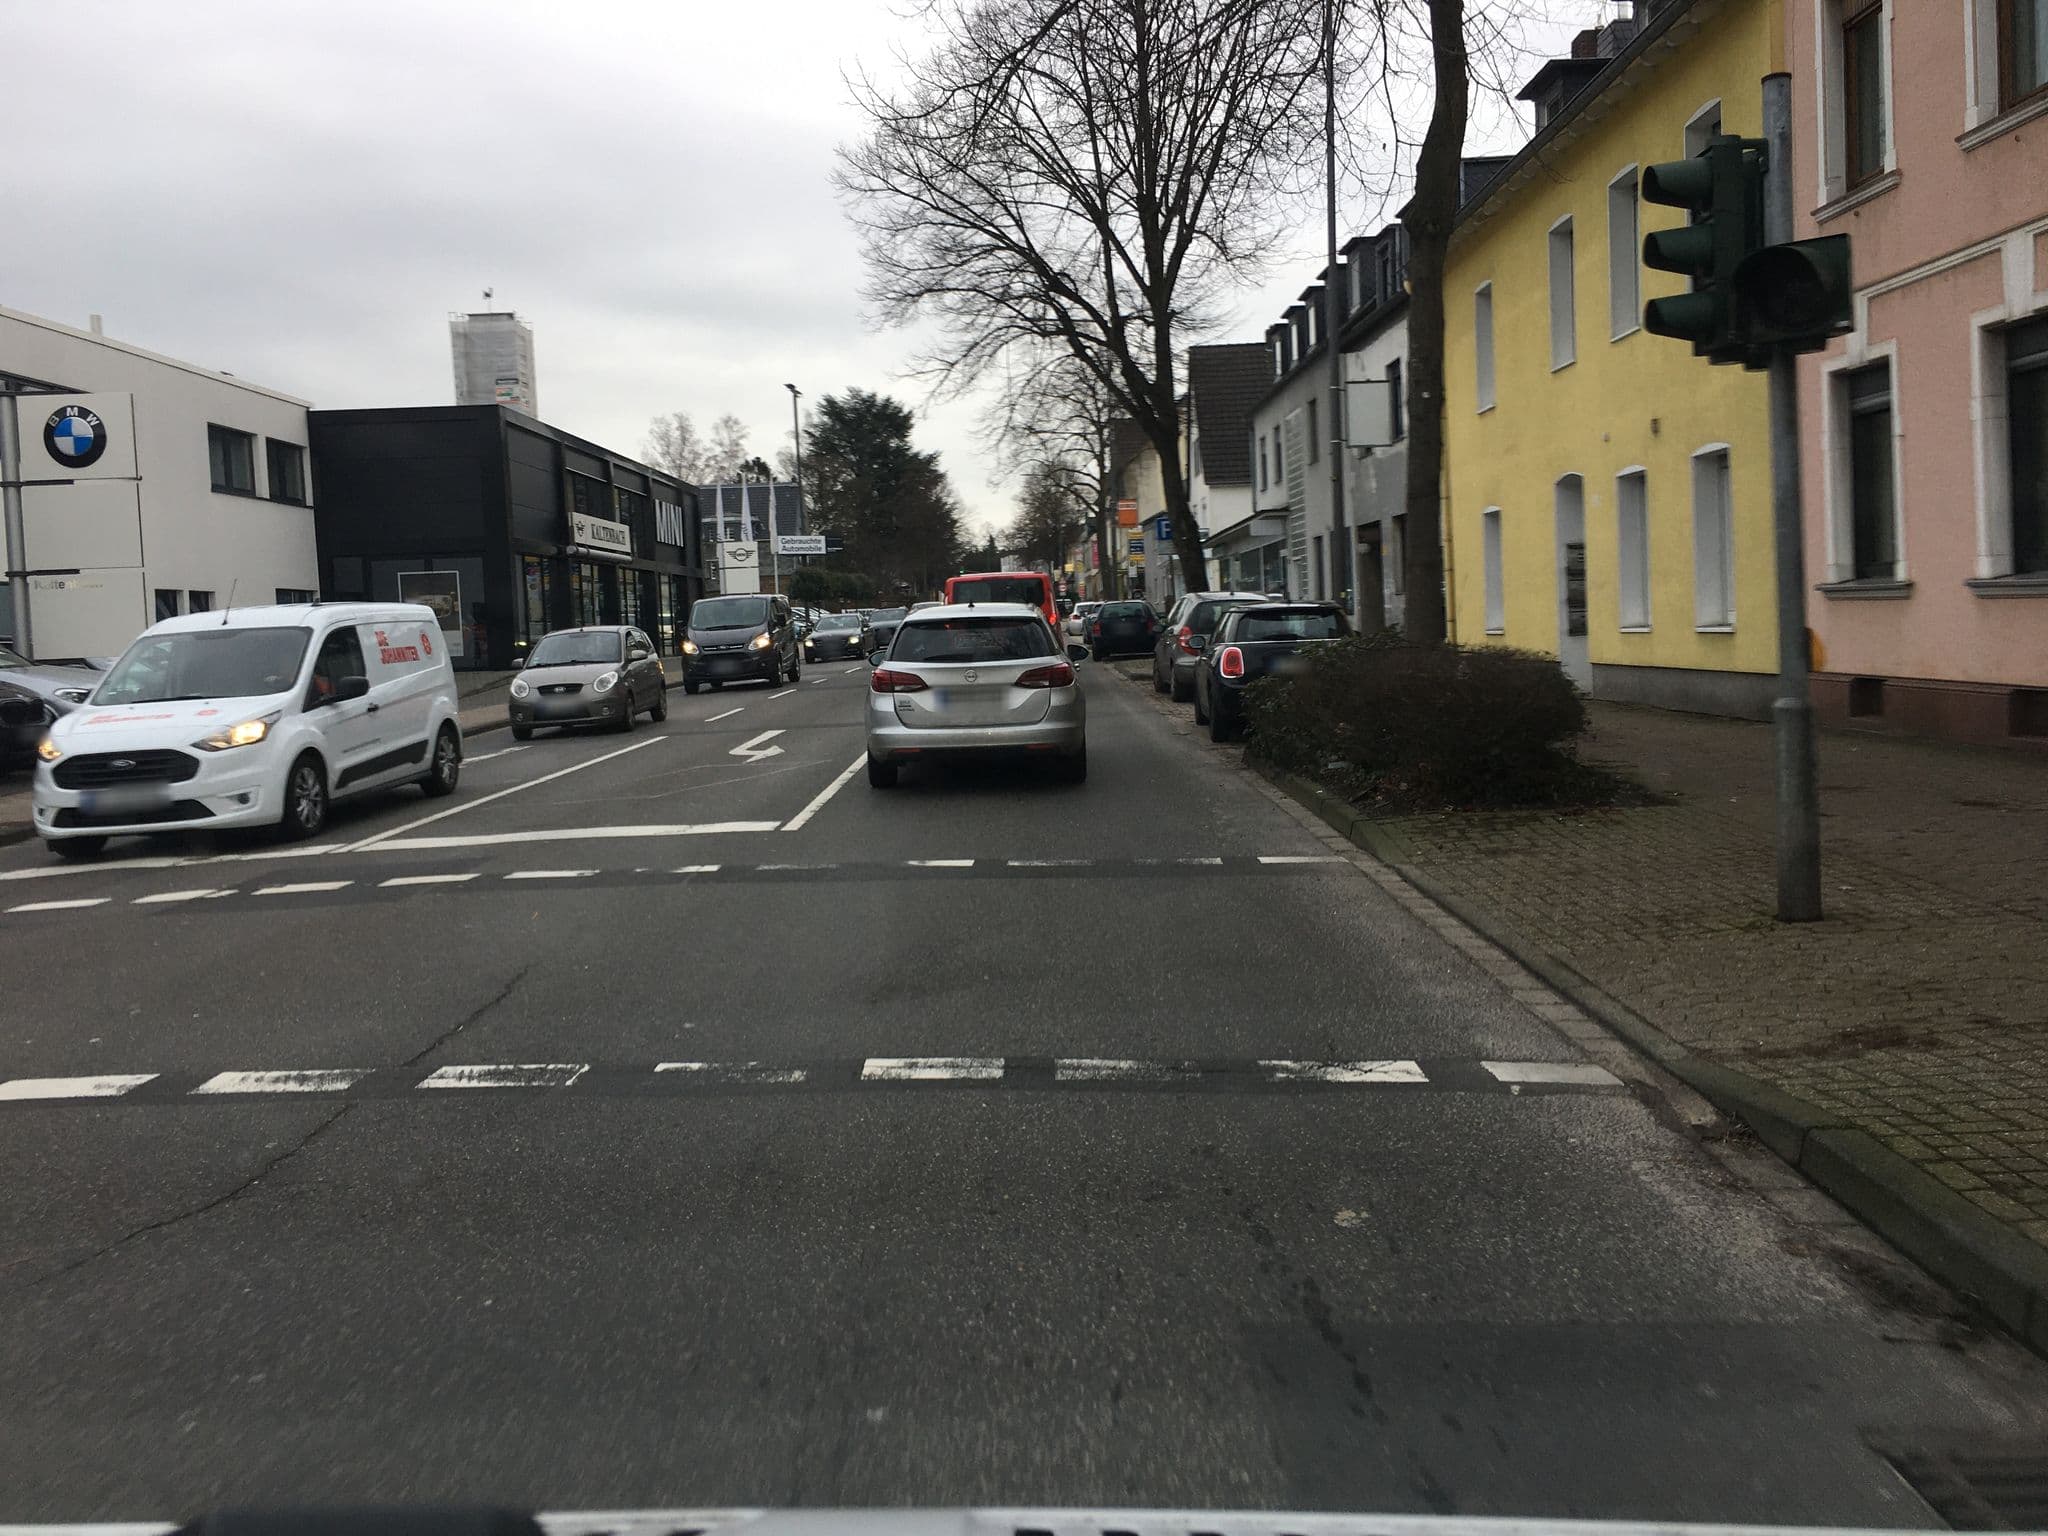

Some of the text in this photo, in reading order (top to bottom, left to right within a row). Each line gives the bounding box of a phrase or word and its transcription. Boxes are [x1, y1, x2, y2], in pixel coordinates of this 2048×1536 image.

[48, 406, 100, 427] BMW
[655, 499, 684, 548] MINI
[781, 537, 822, 545] Gebrauchte
[781, 545, 823, 553] Automobile
